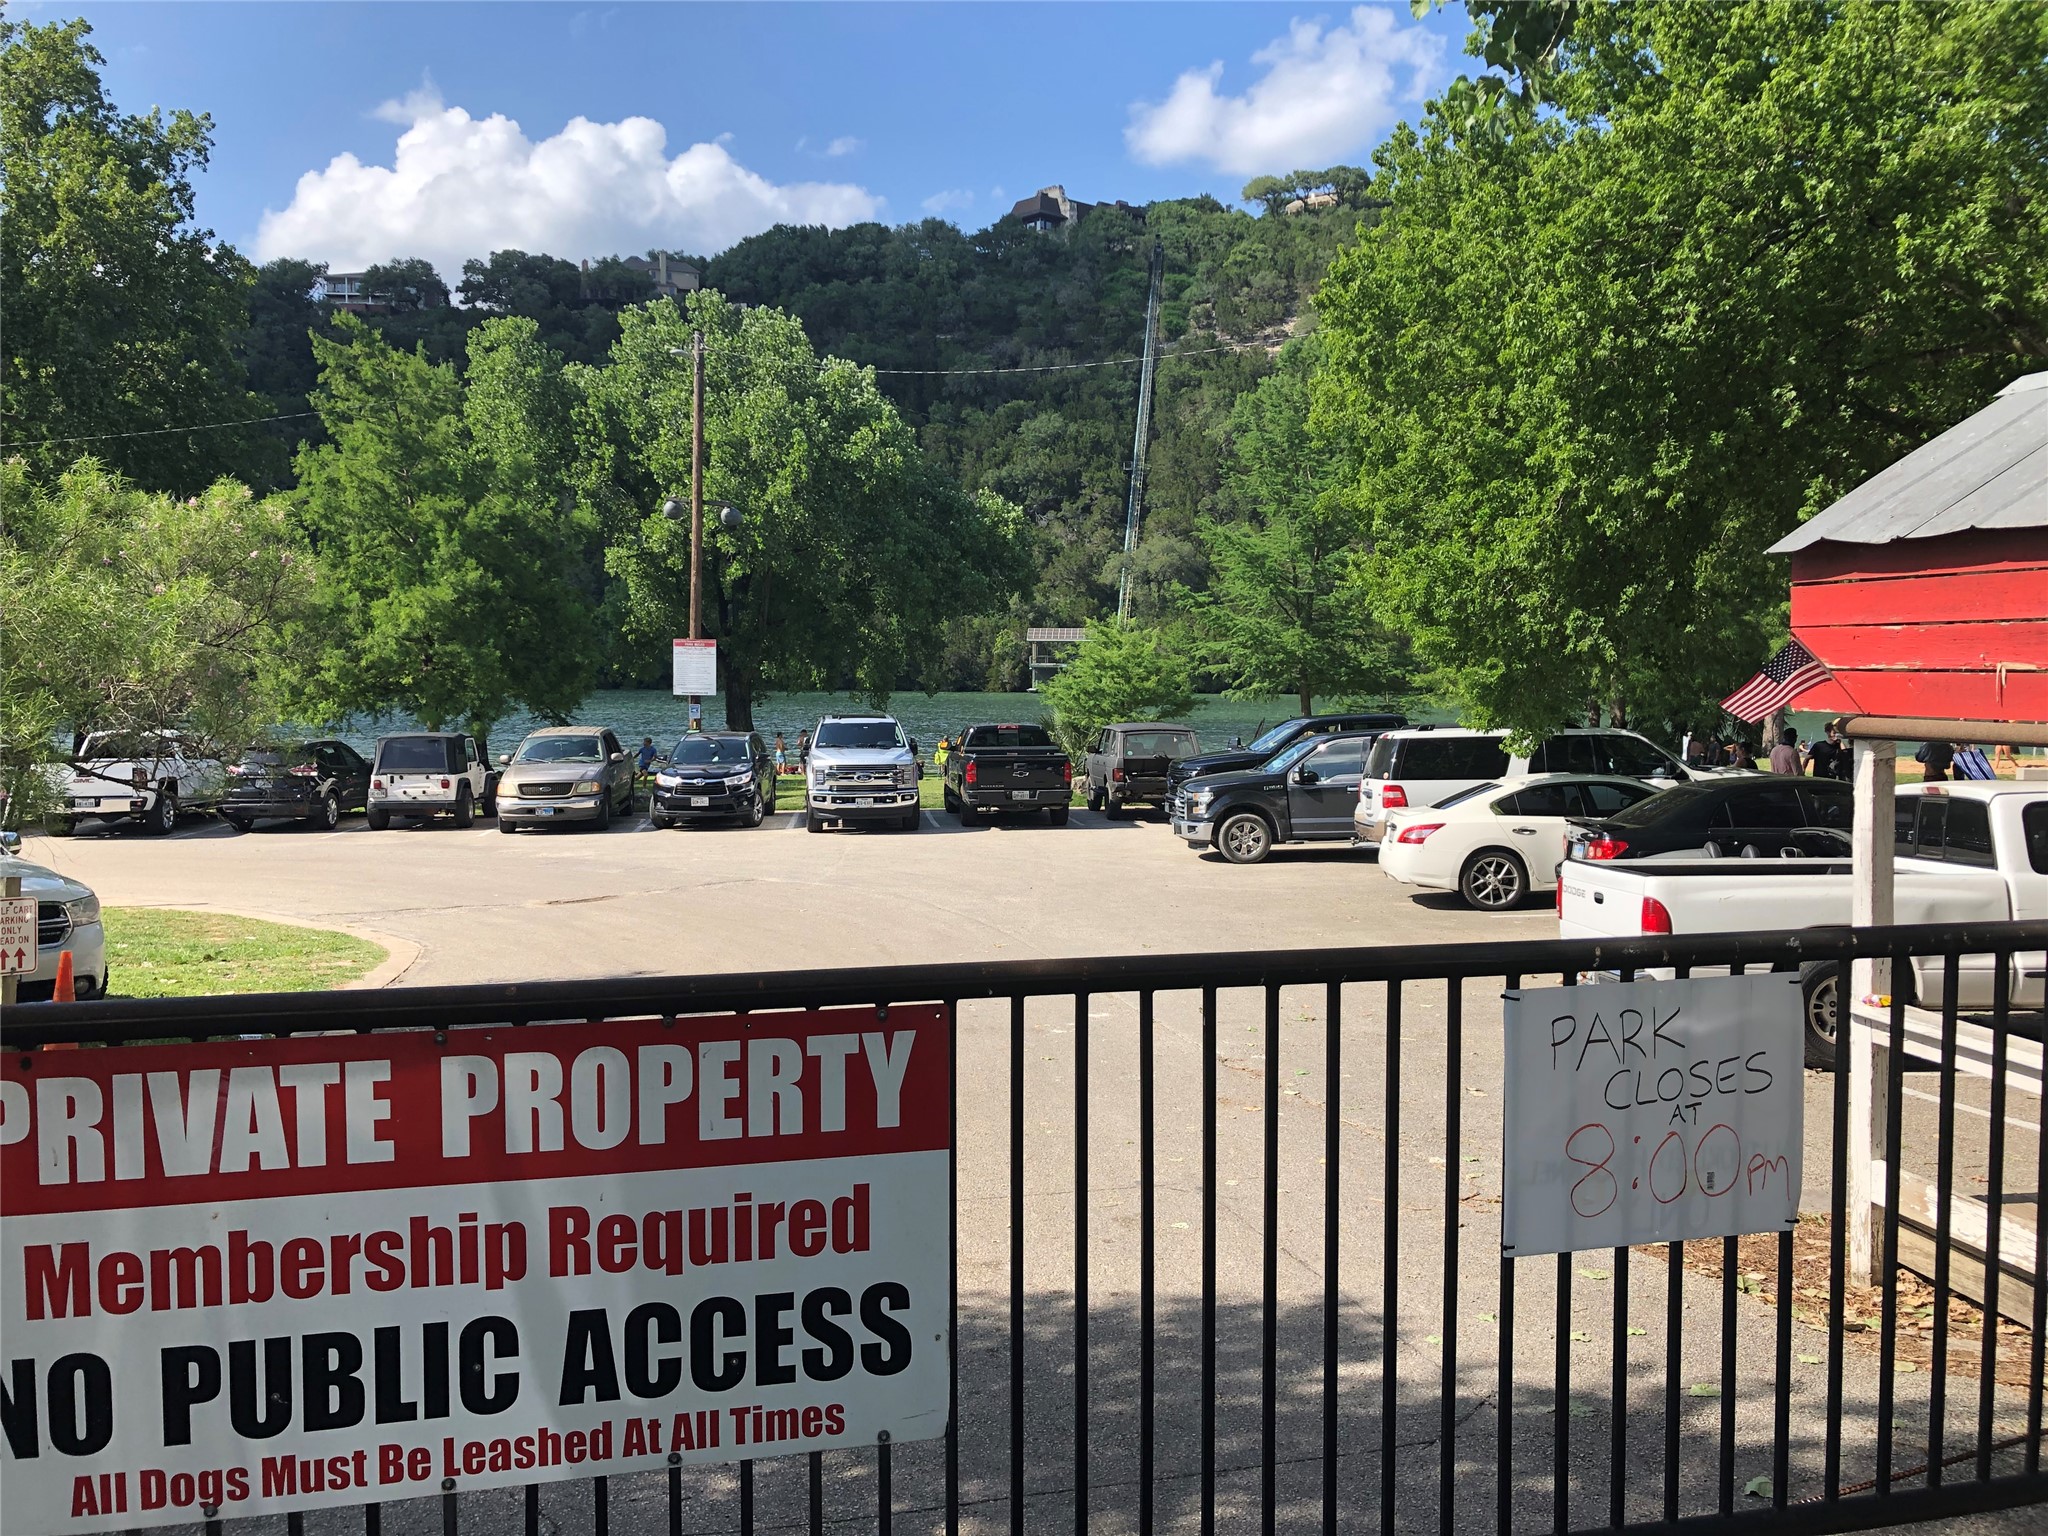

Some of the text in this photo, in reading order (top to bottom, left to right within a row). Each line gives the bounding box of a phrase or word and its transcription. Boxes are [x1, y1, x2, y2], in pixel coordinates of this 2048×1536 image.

[13, 905, 33, 915] CART
[1563, 885, 1586, 898] DODGE
[1, 926, 22, 935] ONLY
[18, 935, 29, 944] ON
[1550, 1006, 1686, 1071] PARK
[441, 1030, 916, 1157] PROPERTY
[1604, 1051, 1773, 1110] CLOSES
[1668, 1101, 1703, 1126] AT
[1565, 1123, 1741, 1218] 8:00
[25, 1184, 869, 1320] Membership Required
[0, 1282, 911, 1459] NO PUBLIC ACCESS
[72, 1404, 844, 1516] All Dogs Must Be Leashed At All Times
